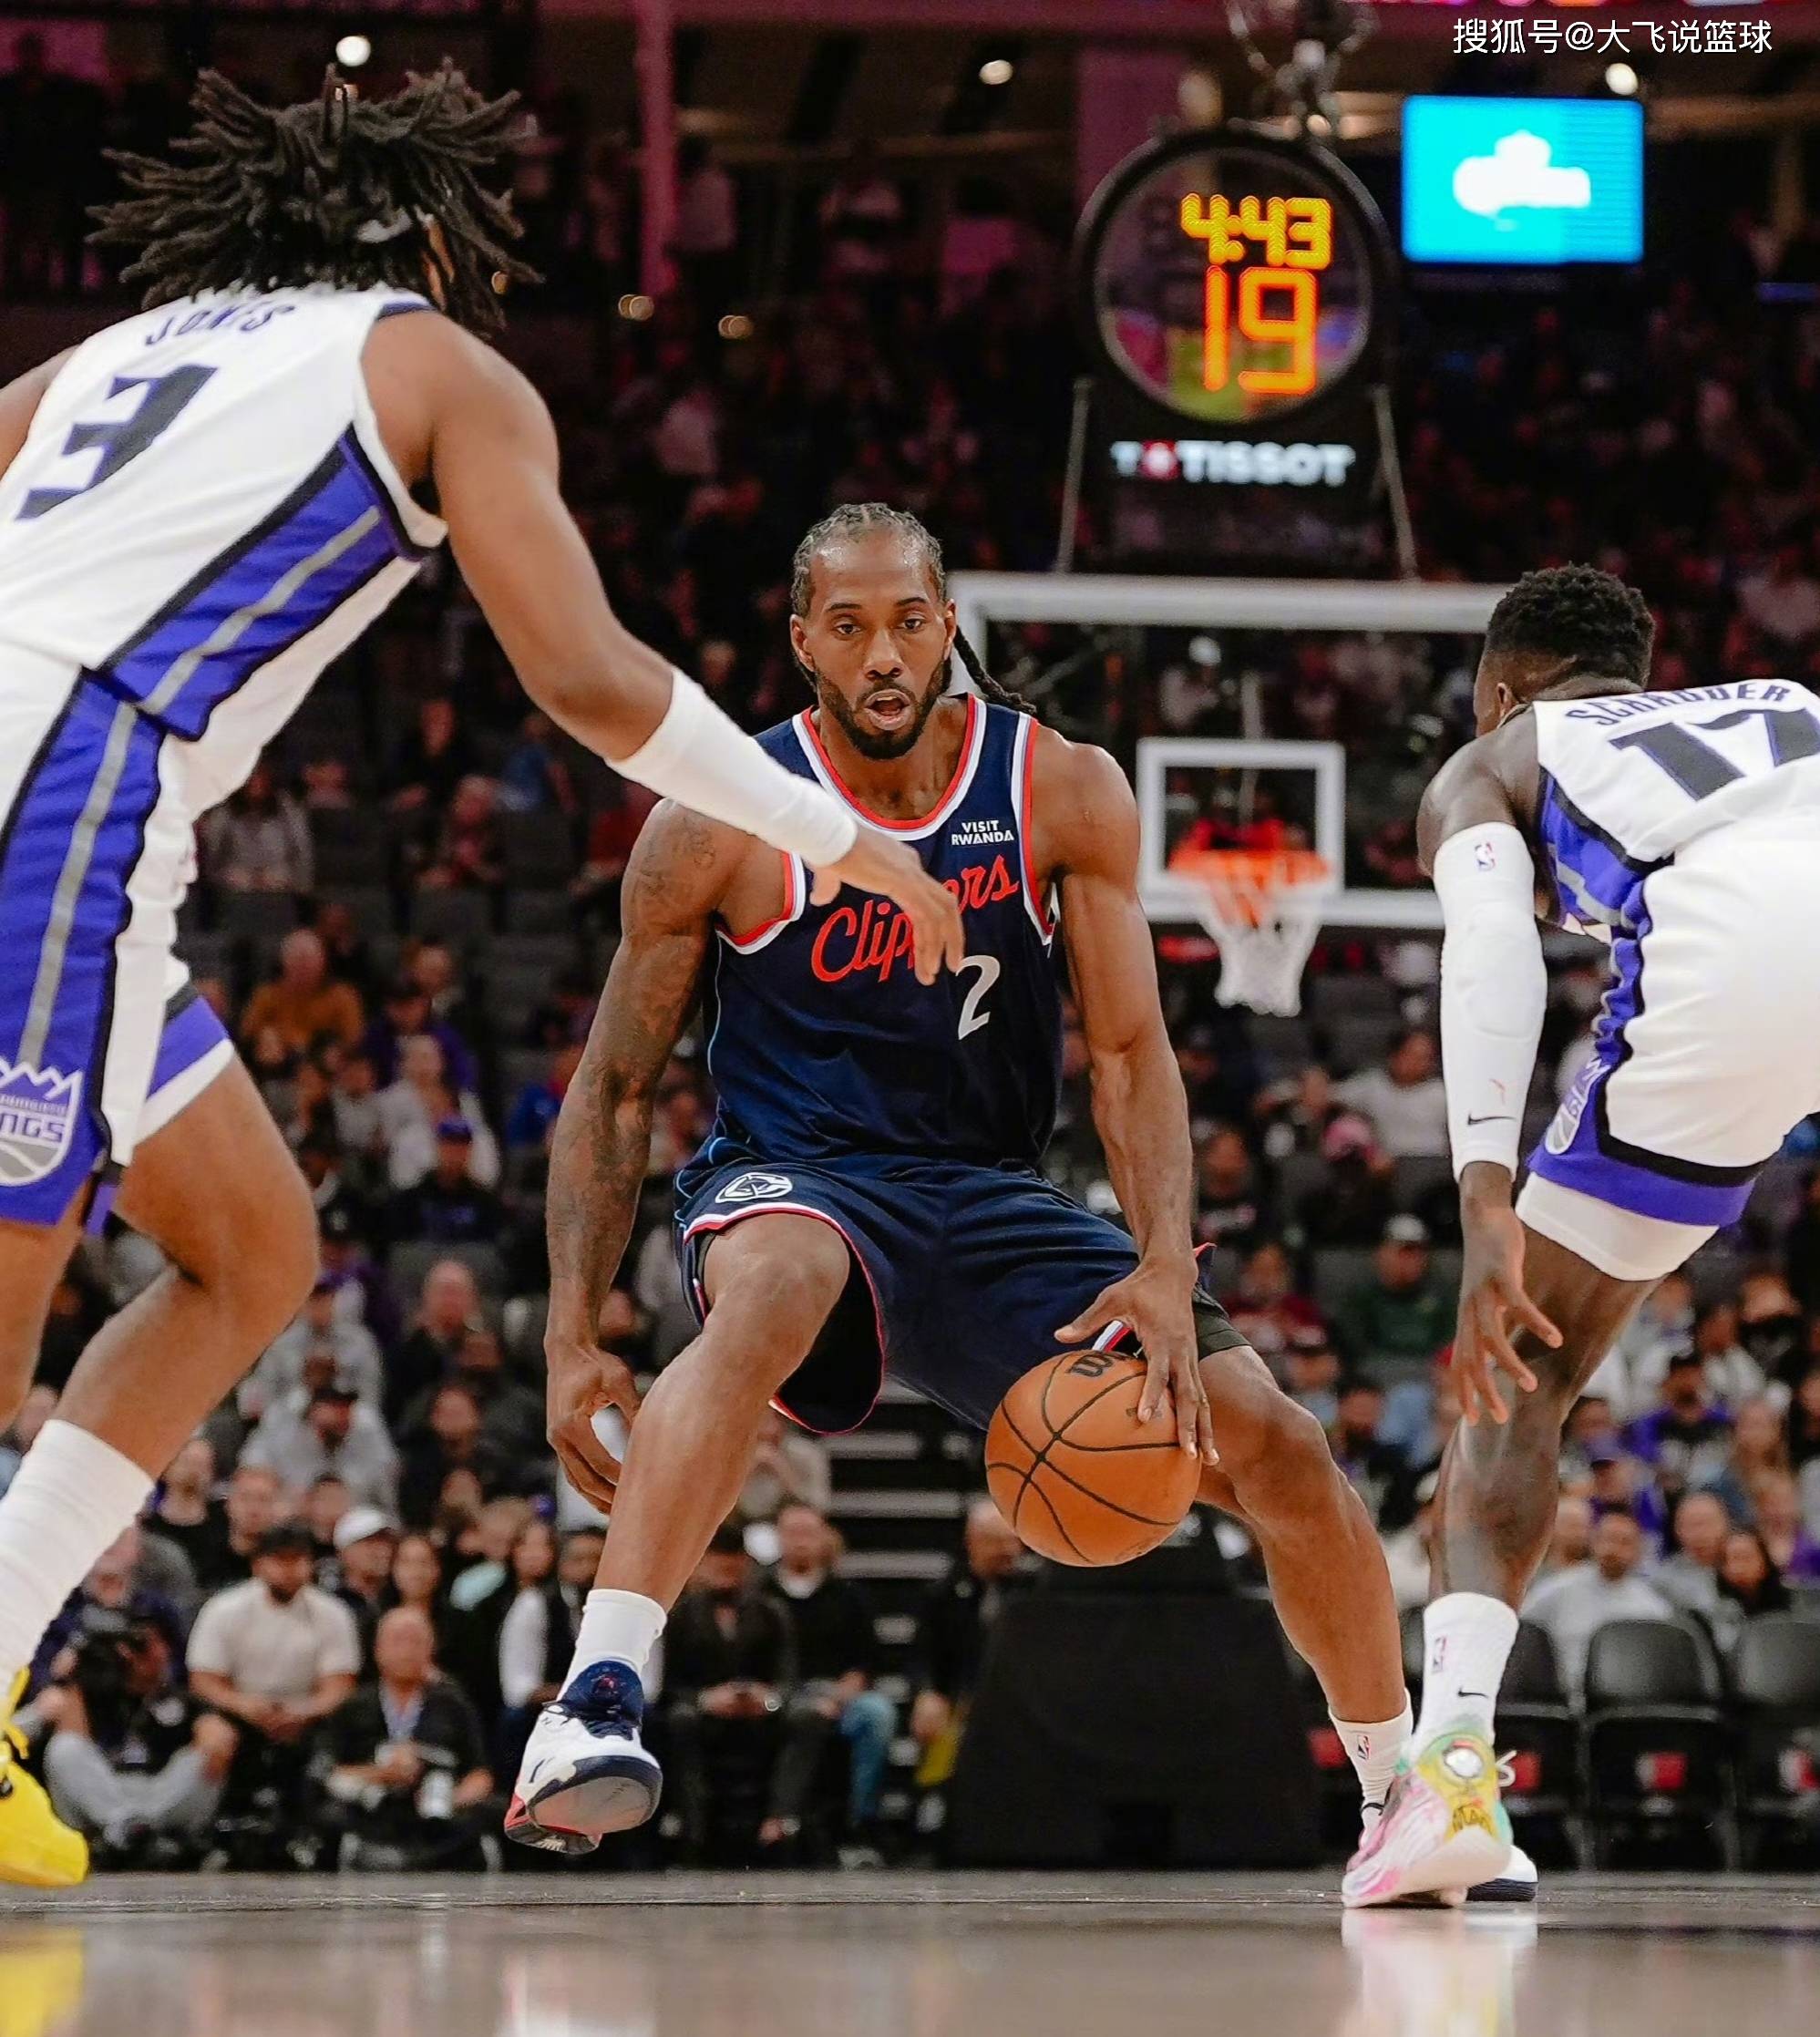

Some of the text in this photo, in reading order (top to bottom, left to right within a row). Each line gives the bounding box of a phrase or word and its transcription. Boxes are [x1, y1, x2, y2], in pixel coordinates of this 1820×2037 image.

[1181, 192, 1332, 270] 4:43
[1204, 264, 1318, 395] 19
[14, 363, 219, 521] 3
[1176, 440, 1356, 487] TISSOT
[1608, 706, 1820, 803] 17
[951, 829, 1014, 846] RWANDA
[961, 819, 1000, 833] VISIT
[954, 953, 1002, 1041] 2
